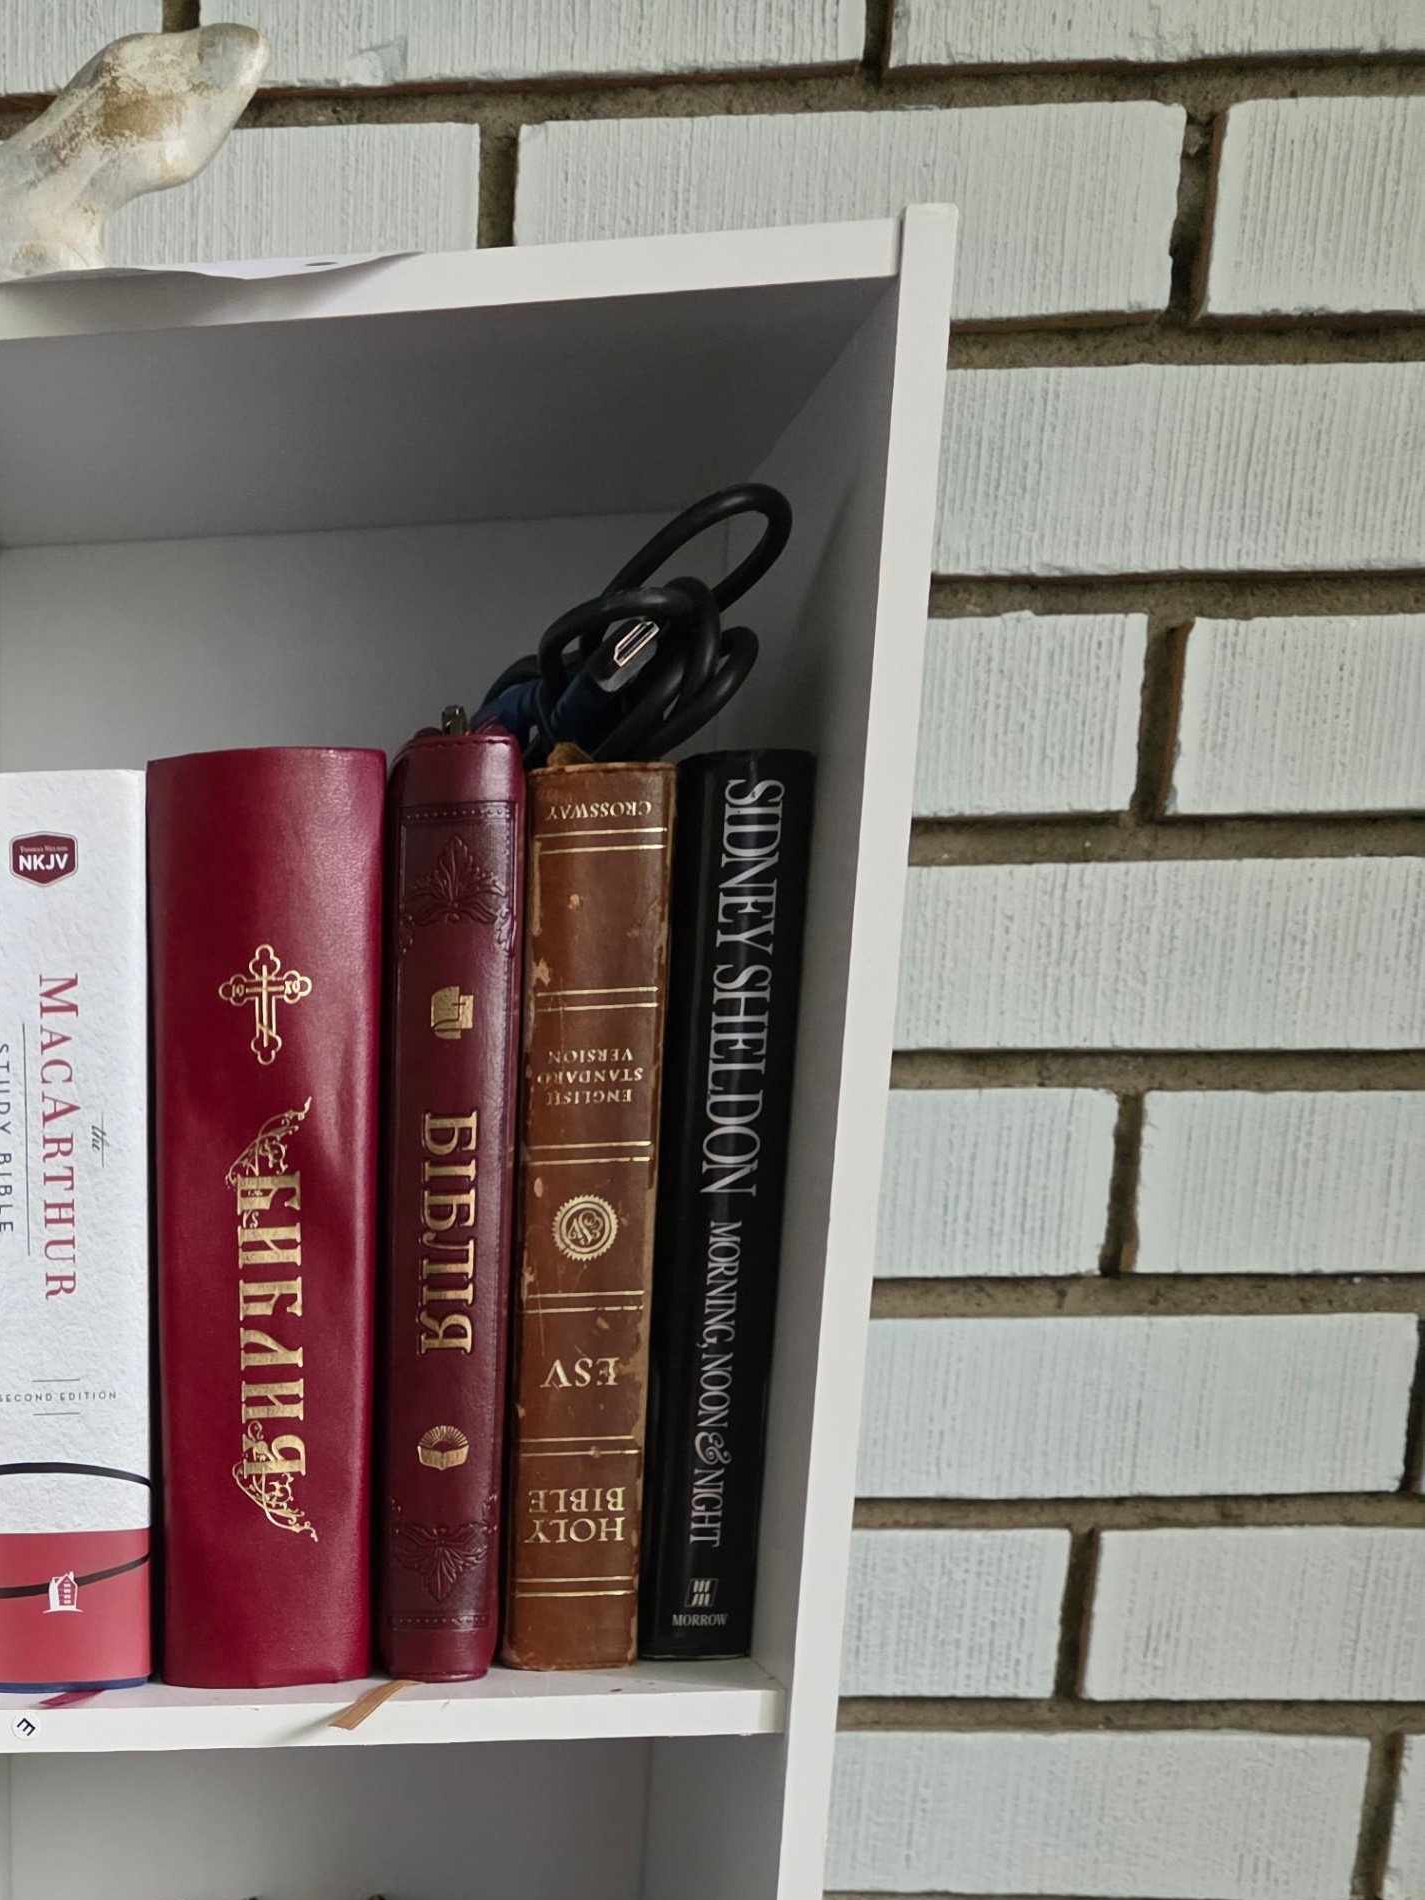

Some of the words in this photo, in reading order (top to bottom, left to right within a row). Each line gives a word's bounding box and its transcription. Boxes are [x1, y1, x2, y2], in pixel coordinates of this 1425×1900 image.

[545, 800, 652, 822] CROSSWAY
[18, 853, 69, 872] NKJV
[716, 779, 785, 955] SIDNEY
[548, 1048, 634, 1063] VERSION
[537, 1067, 644, 1084] STANDARD
[699, 964, 773, 1196] SHELDON
[547, 1089, 632, 1106] ENGLISH
[39, 973, 81, 1300] MACARTHUR
[420, 1110, 478, 1356] БІБЛІЯ
[695, 1220, 742, 1349] MORNING,
[236, 1169, 308, 1480] БИБЛИЯ
[540, 1356, 621, 1388] ESV
[59, 1391, 118, 1401] EDITION
[696, 1353, 733, 1428] NOON
[694, 1431, 732, 1466] &
[528, 1487, 626, 1513] BIBLE
[689, 1468, 725, 1548] NIGHT
[524, 1516, 626, 1544] HOLY
[671, 1612, 728, 1627] MORROW
